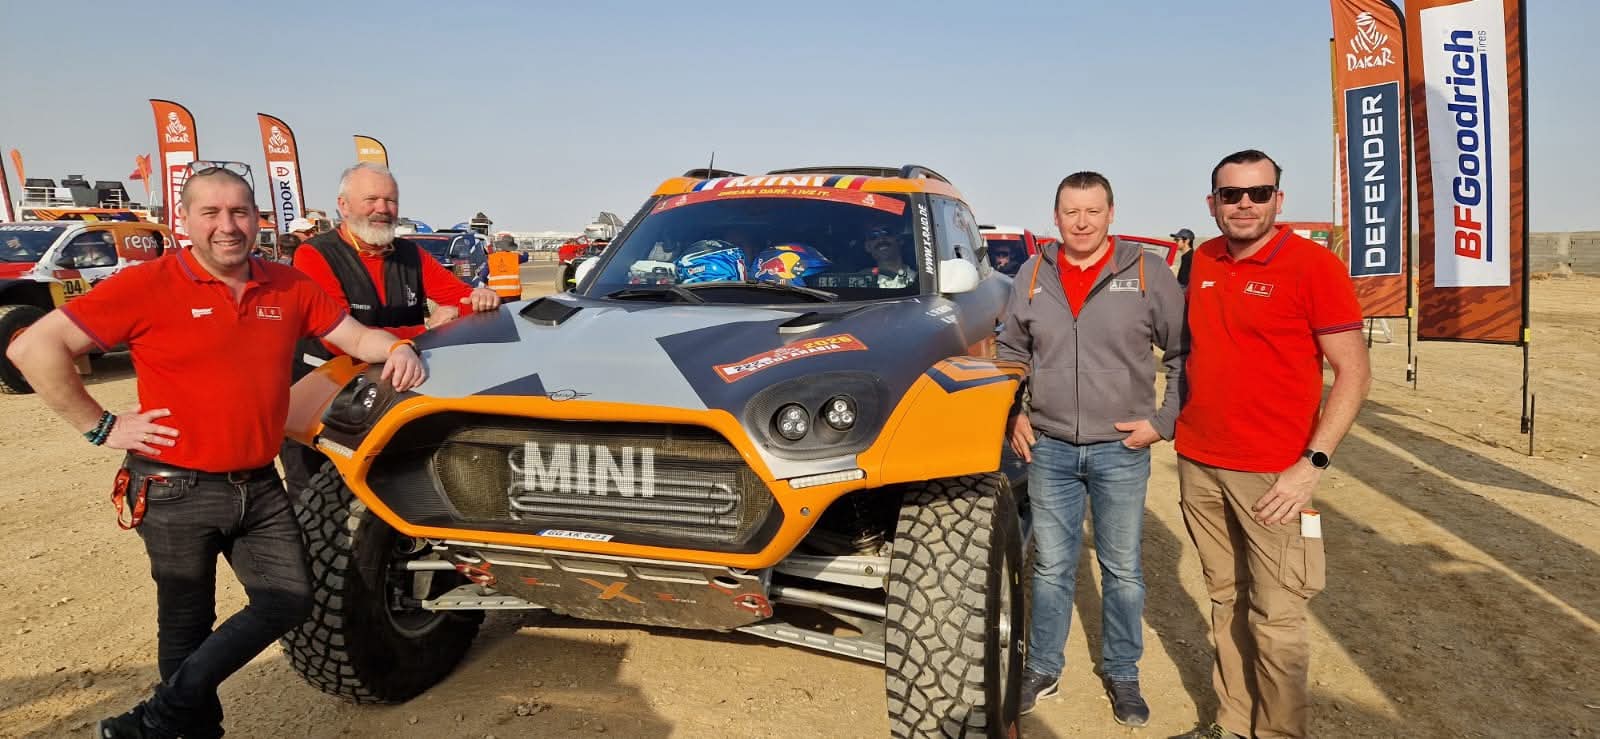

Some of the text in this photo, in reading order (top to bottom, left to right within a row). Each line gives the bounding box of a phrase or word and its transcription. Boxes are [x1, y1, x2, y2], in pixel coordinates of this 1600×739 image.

[1476, 30, 1487, 53] Tires
[1345, 47, 1396, 71] DAKAR
[165, 133, 190, 144] DAKAR
[268, 144, 291, 154] DAKAR
[1443, 29, 1482, 260] BFGoodrich
[723, 175, 825, 188] MINI
[1362, 92, 1386, 268] DEFENDER
[523, 440, 655, 498] MINI
